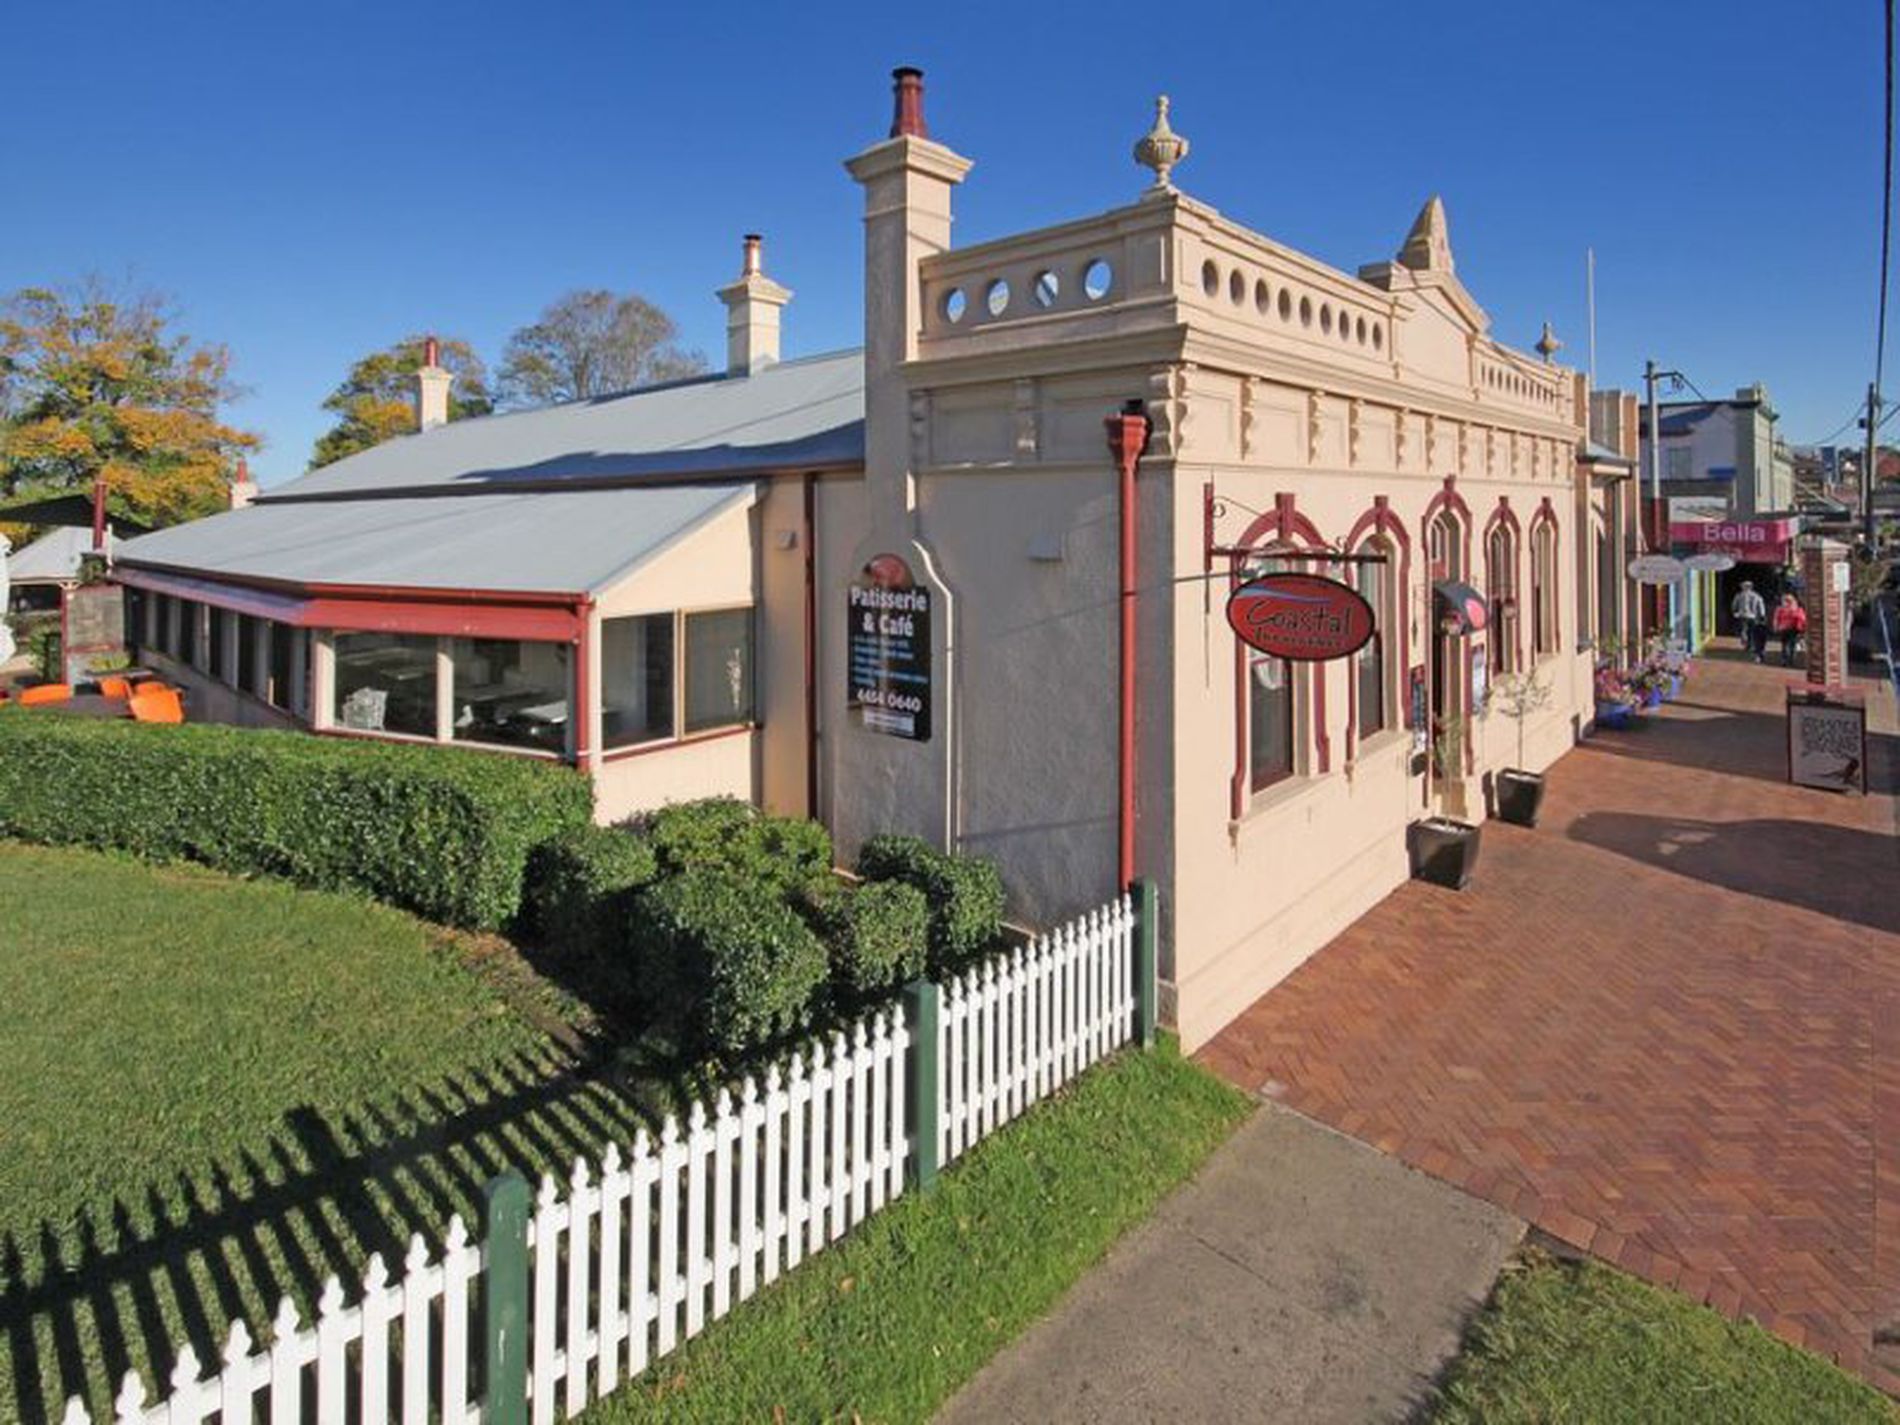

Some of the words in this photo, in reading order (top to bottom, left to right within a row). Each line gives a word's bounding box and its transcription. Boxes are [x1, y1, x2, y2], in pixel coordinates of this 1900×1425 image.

[1704, 523, 1765, 542] Bella
[851, 586, 928, 611] Patisserie
[862, 613, 873, 633] &
[879, 615, 914, 636] Café
[1246, 600, 1351, 636] Coastal
